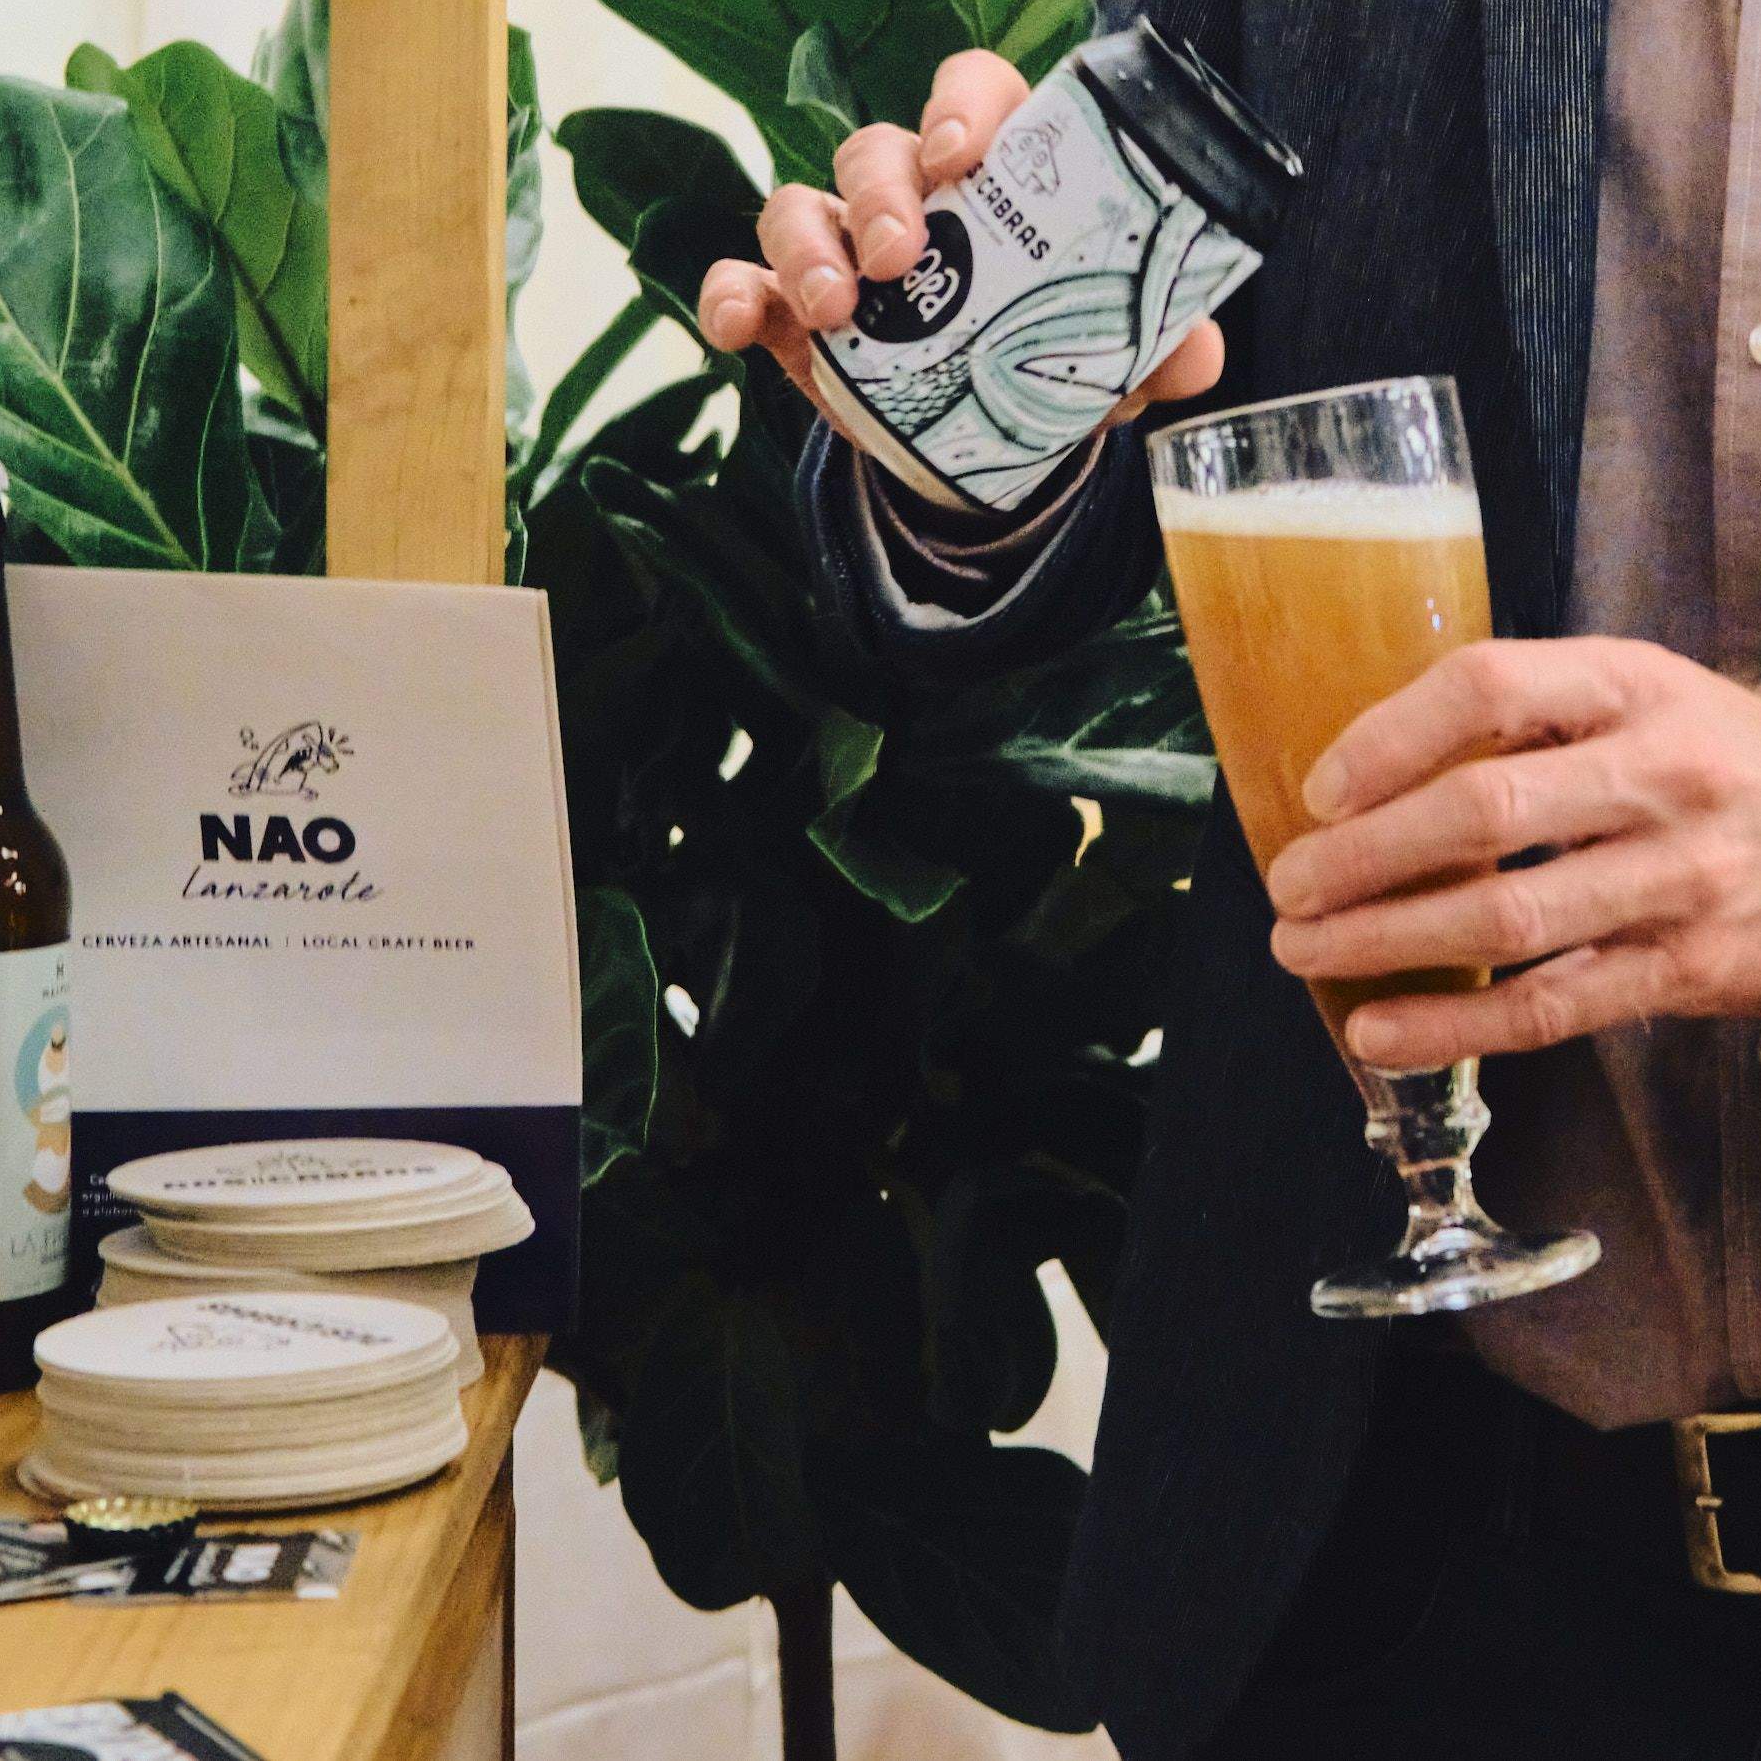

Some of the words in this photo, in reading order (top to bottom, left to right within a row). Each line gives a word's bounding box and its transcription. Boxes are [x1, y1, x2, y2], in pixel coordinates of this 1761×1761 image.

[199, 812, 356, 864] NAO
[82, 935, 164, 950] CERVEZA
[169, 935, 272, 950] ARTESANAL
[302, 935, 361, 950] LOCAL
[368, 935, 427, 950] CRAFT
[432, 935, 477, 950] BEER
